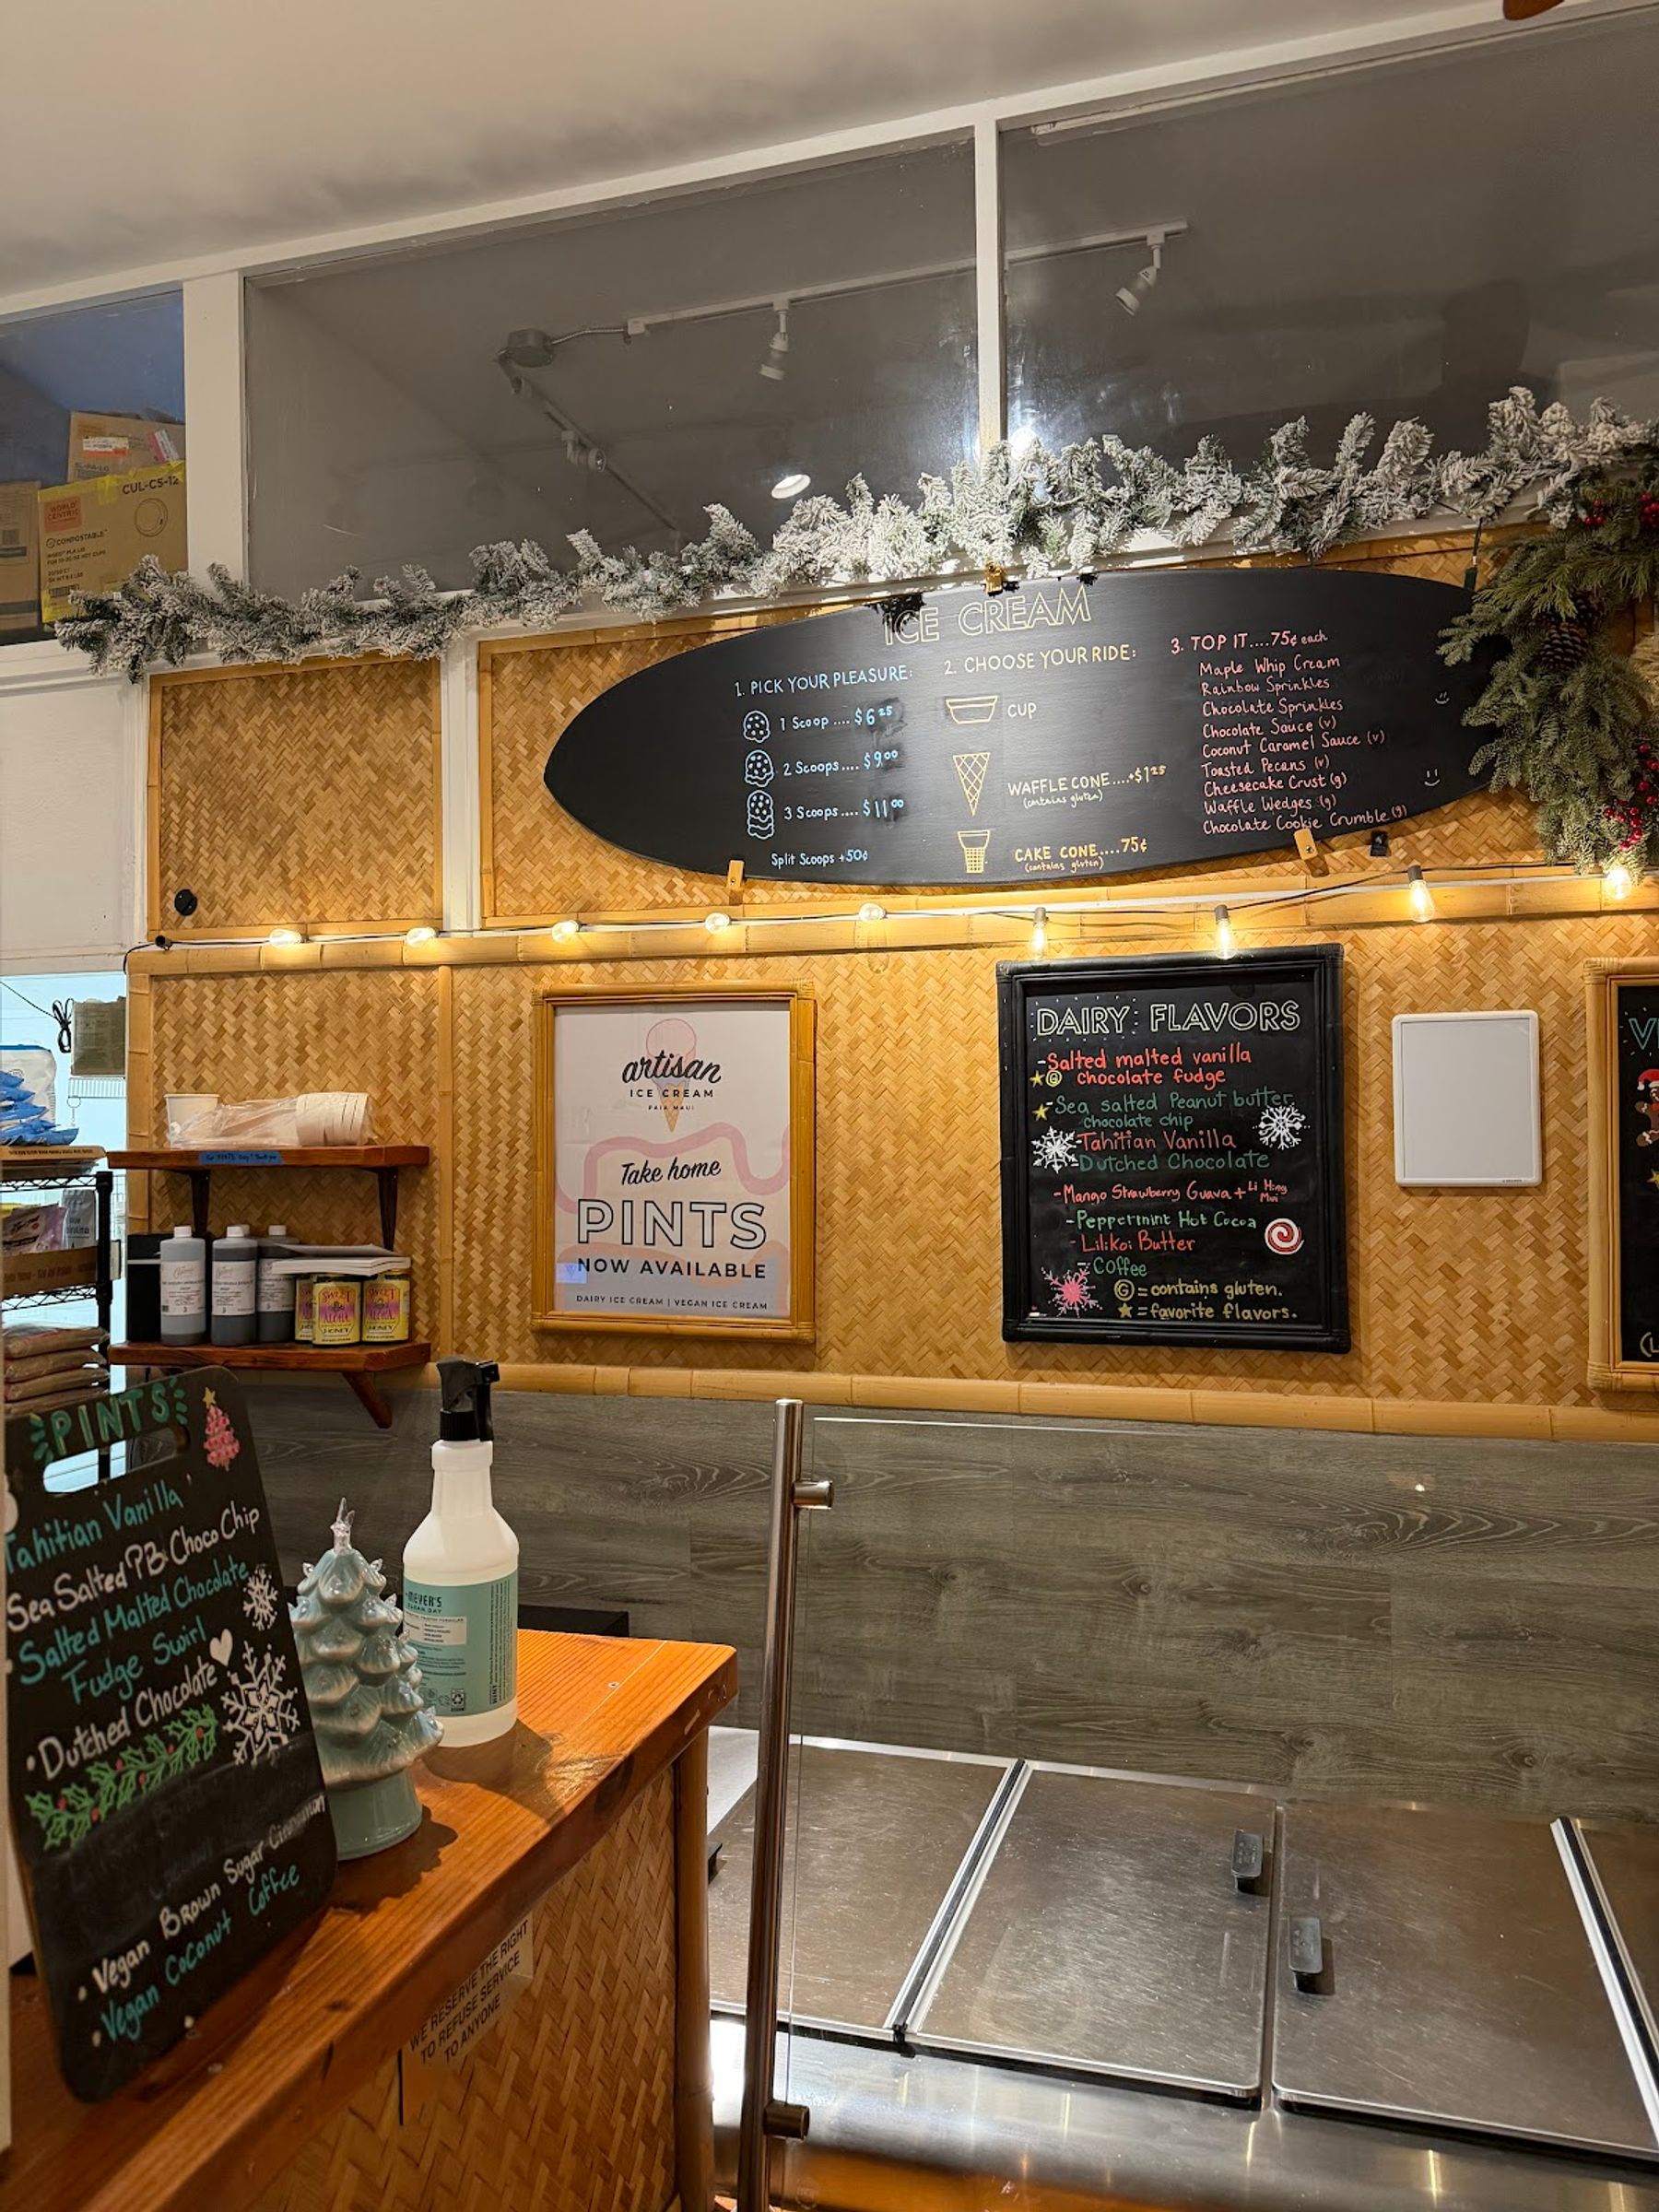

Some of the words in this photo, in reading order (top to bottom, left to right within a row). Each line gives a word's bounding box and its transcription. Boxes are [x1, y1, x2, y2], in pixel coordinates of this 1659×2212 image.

[884, 607, 939, 645] ICE
[959, 584, 1091, 636] CREAM
[1191, 634, 1227, 651] TOP
[1300, 629, 1328, 644] each
[965, 653, 1035, 673] CHOOSE
[1040, 646, 1088, 670] YOUR
[1199, 660, 1244, 679] Maple
[1254, 656, 1286, 677] Whip
[1293, 653, 1341, 671] Cream
[750, 678, 783, 695] PICK
[787, 673, 830, 693] YOUR
[1201, 679, 1260, 697] Rainbow
[1266, 675, 1330, 696] Sprinkles
[1007, 702, 1037, 720] CUP
[1202, 699, 1275, 717] Chocolate
[1278, 697, 1344, 718] Sprinkles
[780, 717, 786, 731] 1
[1202, 724, 1264, 738] Chocolate
[1271, 718, 1313, 735] Sauce
[1318, 717, 1336, 730] (v)
[1202, 739, 1252, 759] Coconut
[1259, 734, 1315, 753] Caramel
[1322, 731, 1361, 748] Sauce
[1367, 729, 1385, 745] (v)
[783, 763, 792, 776] 2
[1201, 761, 1254, 778] Toasted
[1261, 757, 1306, 772] Pecans
[1008, 777, 1068, 796] WAFFLE
[1204, 775, 1284, 798] Cheesecake
[1288, 773, 1326, 790] Crust
[783, 806, 792, 820] 3
[1204, 799, 1256, 816] Waffle
[1261, 795, 1312, 818] Wedges
[1203, 817, 1272, 835] Chocolate
[1277, 815, 1323, 830] Cookie
[1330, 809, 1390, 828] Crumble
[771, 853, 795, 869] Split
[799, 852, 835, 867] Scoops
[1015, 845, 1052, 863] CAKE
[1037, 1006, 1130, 1036] DAIRY
[1150, 1000, 1300, 1032] FLAVORS
[1629, 1018, 1659, 1050] V
[1115, 1046, 1182, 1067] malted
[1193, 1041, 1253, 1065] vanilla
[621, 1049, 722, 1084] artisan
[1077, 1065, 1163, 1086] chocolate
[1172, 1068, 1226, 1091] fudge
[630, 1089, 653, 1098] ICE
[662, 1088, 713, 1098] CREAM
[1100, 1092, 1158, 1112] salted
[1170, 1090, 1227, 1110] Peanut
[1083, 1113, 1152, 1129] chocolate
[1159, 1112, 1194, 1132] chip
[1162, 1128, 1237, 1151] Vanilla
[621, 1159, 664, 1186] Take
[667, 1157, 722, 1181] home
[1168, 1149, 1271, 1170] Chocolate
[1112, 1183, 1180, 1203] Strawberry
[1186, 1180, 1231, 1201] Guava
[578, 1199, 767, 1250] PINTS
[1179, 1210, 1207, 1229] Hot
[1213, 1211, 1257, 1229] Cocoa
[1138, 1229, 1195, 1252] Butter
[578, 1258, 630, 1273] NOW
[641, 1260, 766, 1278] AVAILABLE
[576, 1295, 606, 1303] DAIRY
[609, 1296, 625, 1304] ICE
[629, 1297, 664, 1305] CREAM
[674, 1299, 708, 1307] VEGAN
[733, 1301, 767, 1310] CREAM
[50, 1382, 171, 1456] PINTS
[5, 1518, 103, 1574] Tahitian
[103, 1479, 184, 1530] Vanilla
[6, 1594, 55, 1631] Sea
[53, 1562, 129, 1611] Salted
[124, 1541, 166, 1580] PB
[170, 1525, 219, 1565] Choco
[220, 1500, 260, 1538] Chip
[18, 1617, 101, 1685] Salted
[103, 1583, 172, 1640] Malted
[173, 1559, 250, 1608] Chocolate
[61, 1654, 143, 1704] Fudge
[152, 1615, 206, 1665] Swirl
[38, 1706, 132, 1781] Dutched
[135, 1655, 218, 1728] Chocolate
[92, 1939, 151, 1994] Vegan
[223, 1841, 265, 1885] Sugar
[100, 1984, 160, 2042] Vegan
[248, 1865, 300, 1916] Coffee
[410, 2023, 428, 2052] WE
[430, 1971, 477, 2031] RESERVE
[480, 1951, 499, 1978] THE
[500, 1919, 528, 1959] RIGHT
[420, 2041, 436, 2065] TO
[439, 1994, 478, 2047] REFUSE
[480, 1950, 520, 2003] SERVICE
[444, 2040, 459, 2065] TO
[460, 1993, 501, 2047] ANYONE
